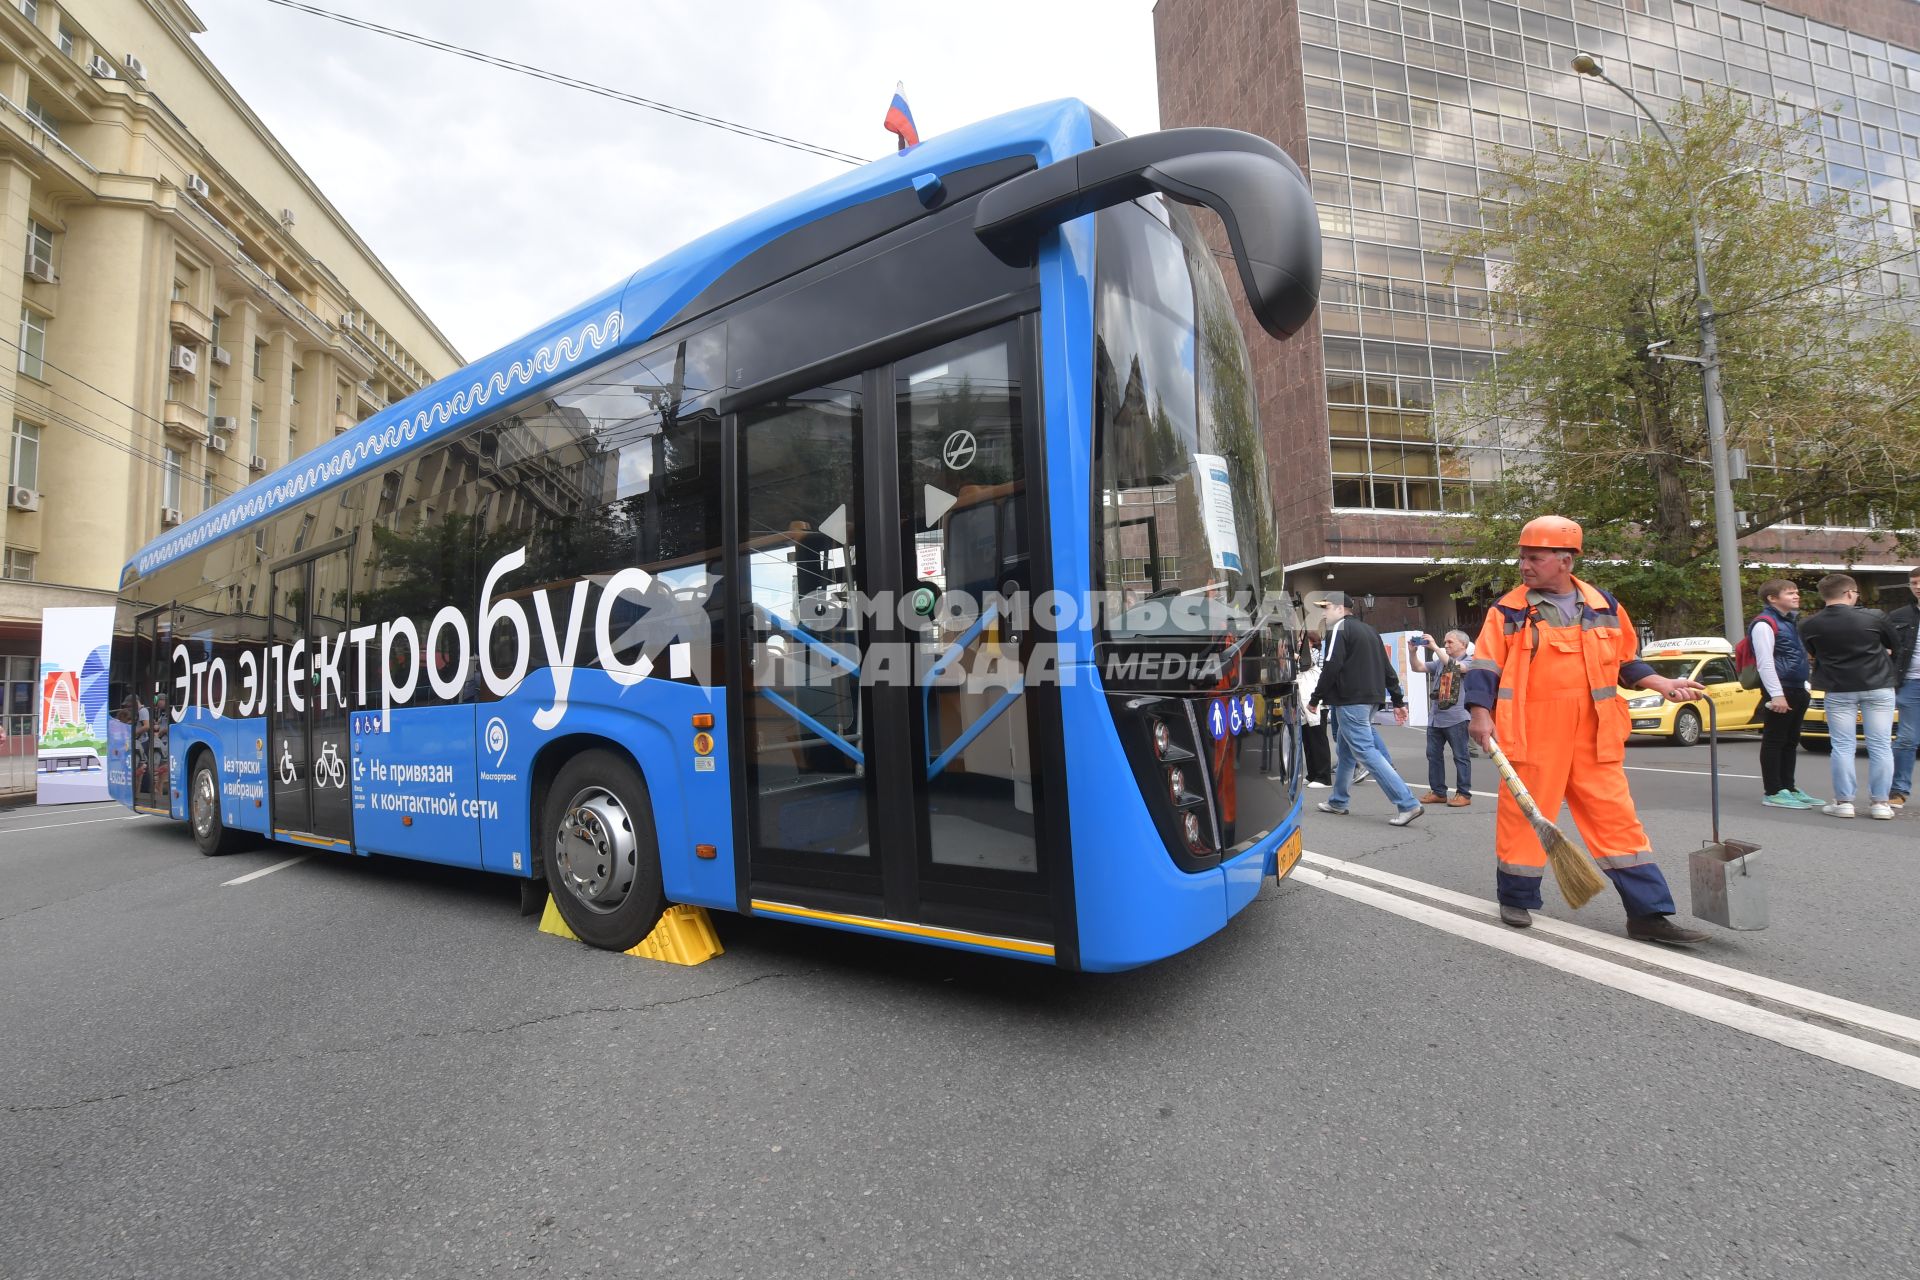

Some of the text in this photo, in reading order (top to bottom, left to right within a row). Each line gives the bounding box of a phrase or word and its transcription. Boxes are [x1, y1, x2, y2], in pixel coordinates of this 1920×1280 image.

[171, 643, 228, 723] Это
[235, 760, 260, 777] тряски
[370, 759, 453, 786] Не привязан
[480, 771, 517, 783] Мосгортранс
[229, 779, 263, 800] вибраций
[371, 793, 498, 820] к контактной сети
